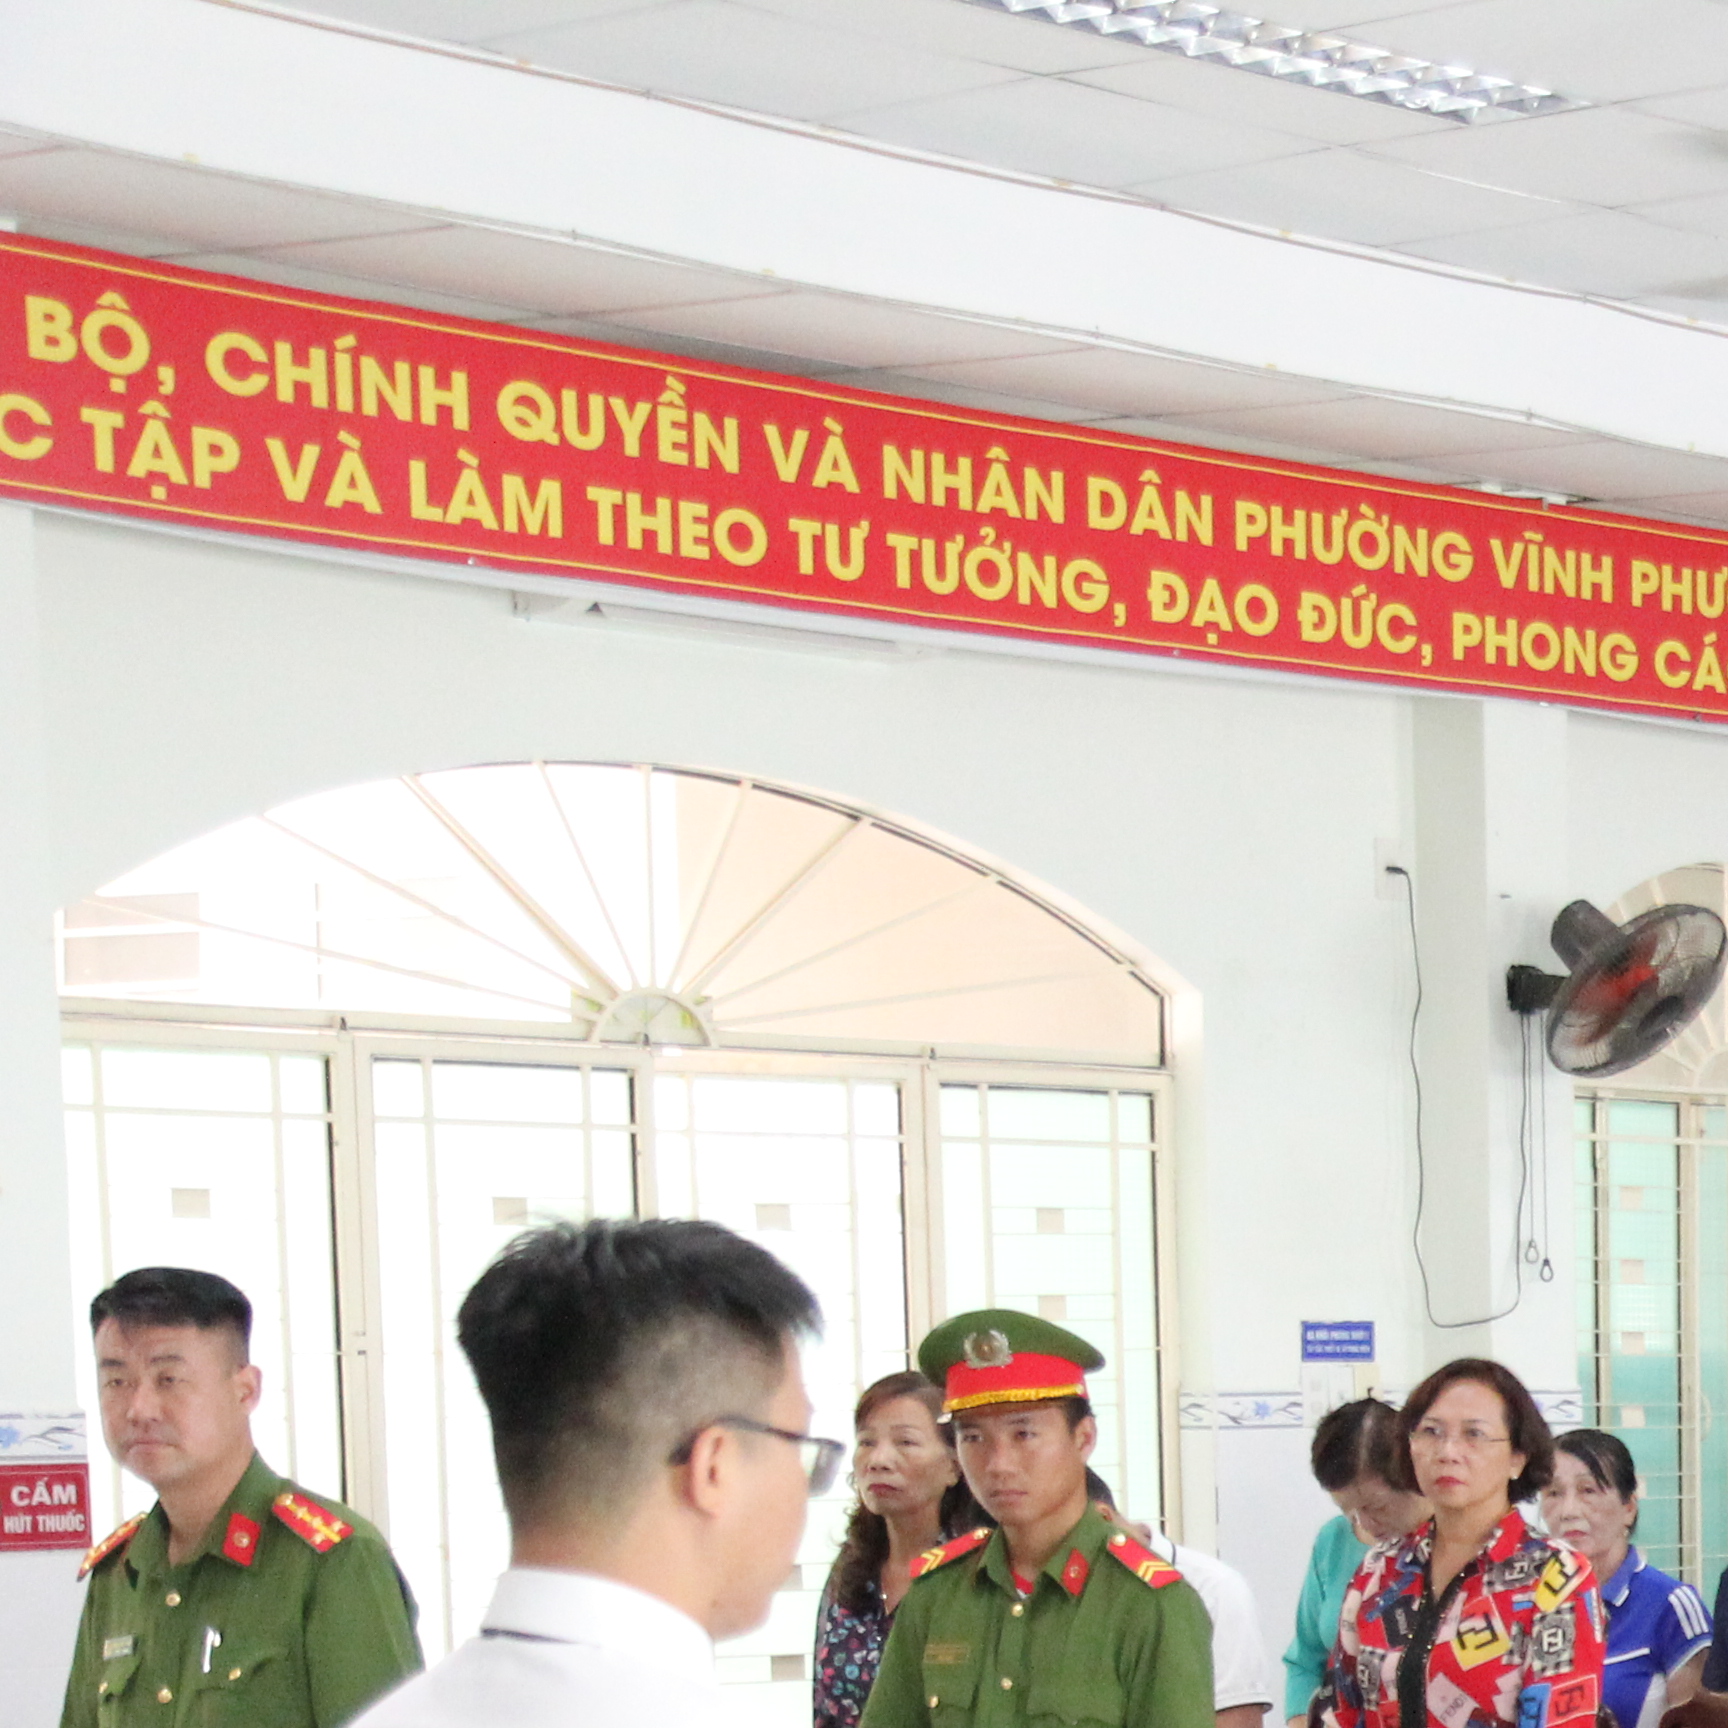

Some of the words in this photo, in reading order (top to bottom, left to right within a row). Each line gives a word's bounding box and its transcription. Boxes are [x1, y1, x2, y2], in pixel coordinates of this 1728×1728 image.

[24, 290, 176, 397] BỘ,
[205, 331, 471, 432] CHÍNH
[495, 375, 741, 475] QUYỀN
[761, 416, 862, 495] VÀ
[881, 444, 1066, 525] NHÂN
[1085, 469, 1215, 548] DÂN
[1233, 499, 1475, 583] PHƯỜNG
[1488, 530, 1614, 605] VĨNH
[79, 398, 242, 503] TẬP
[263, 427, 384, 516] VÀ
[407, 446, 564, 540] LÀM
[585, 484, 769, 568] THEO
[788, 516, 871, 583] TƯ
[884, 524, 1128, 628] TƯỞNG,
[1144, 567, 1280, 648] ĐẠO
[1294, 582, 1434, 668] ĐỨC,
[1451, 610, 1640, 683] PHONG
[3, 1511, 33, 1534] HÚT
[36, 1509, 86, 1533] THUỐC
[10, 1477, 78, 1507] CẤM
